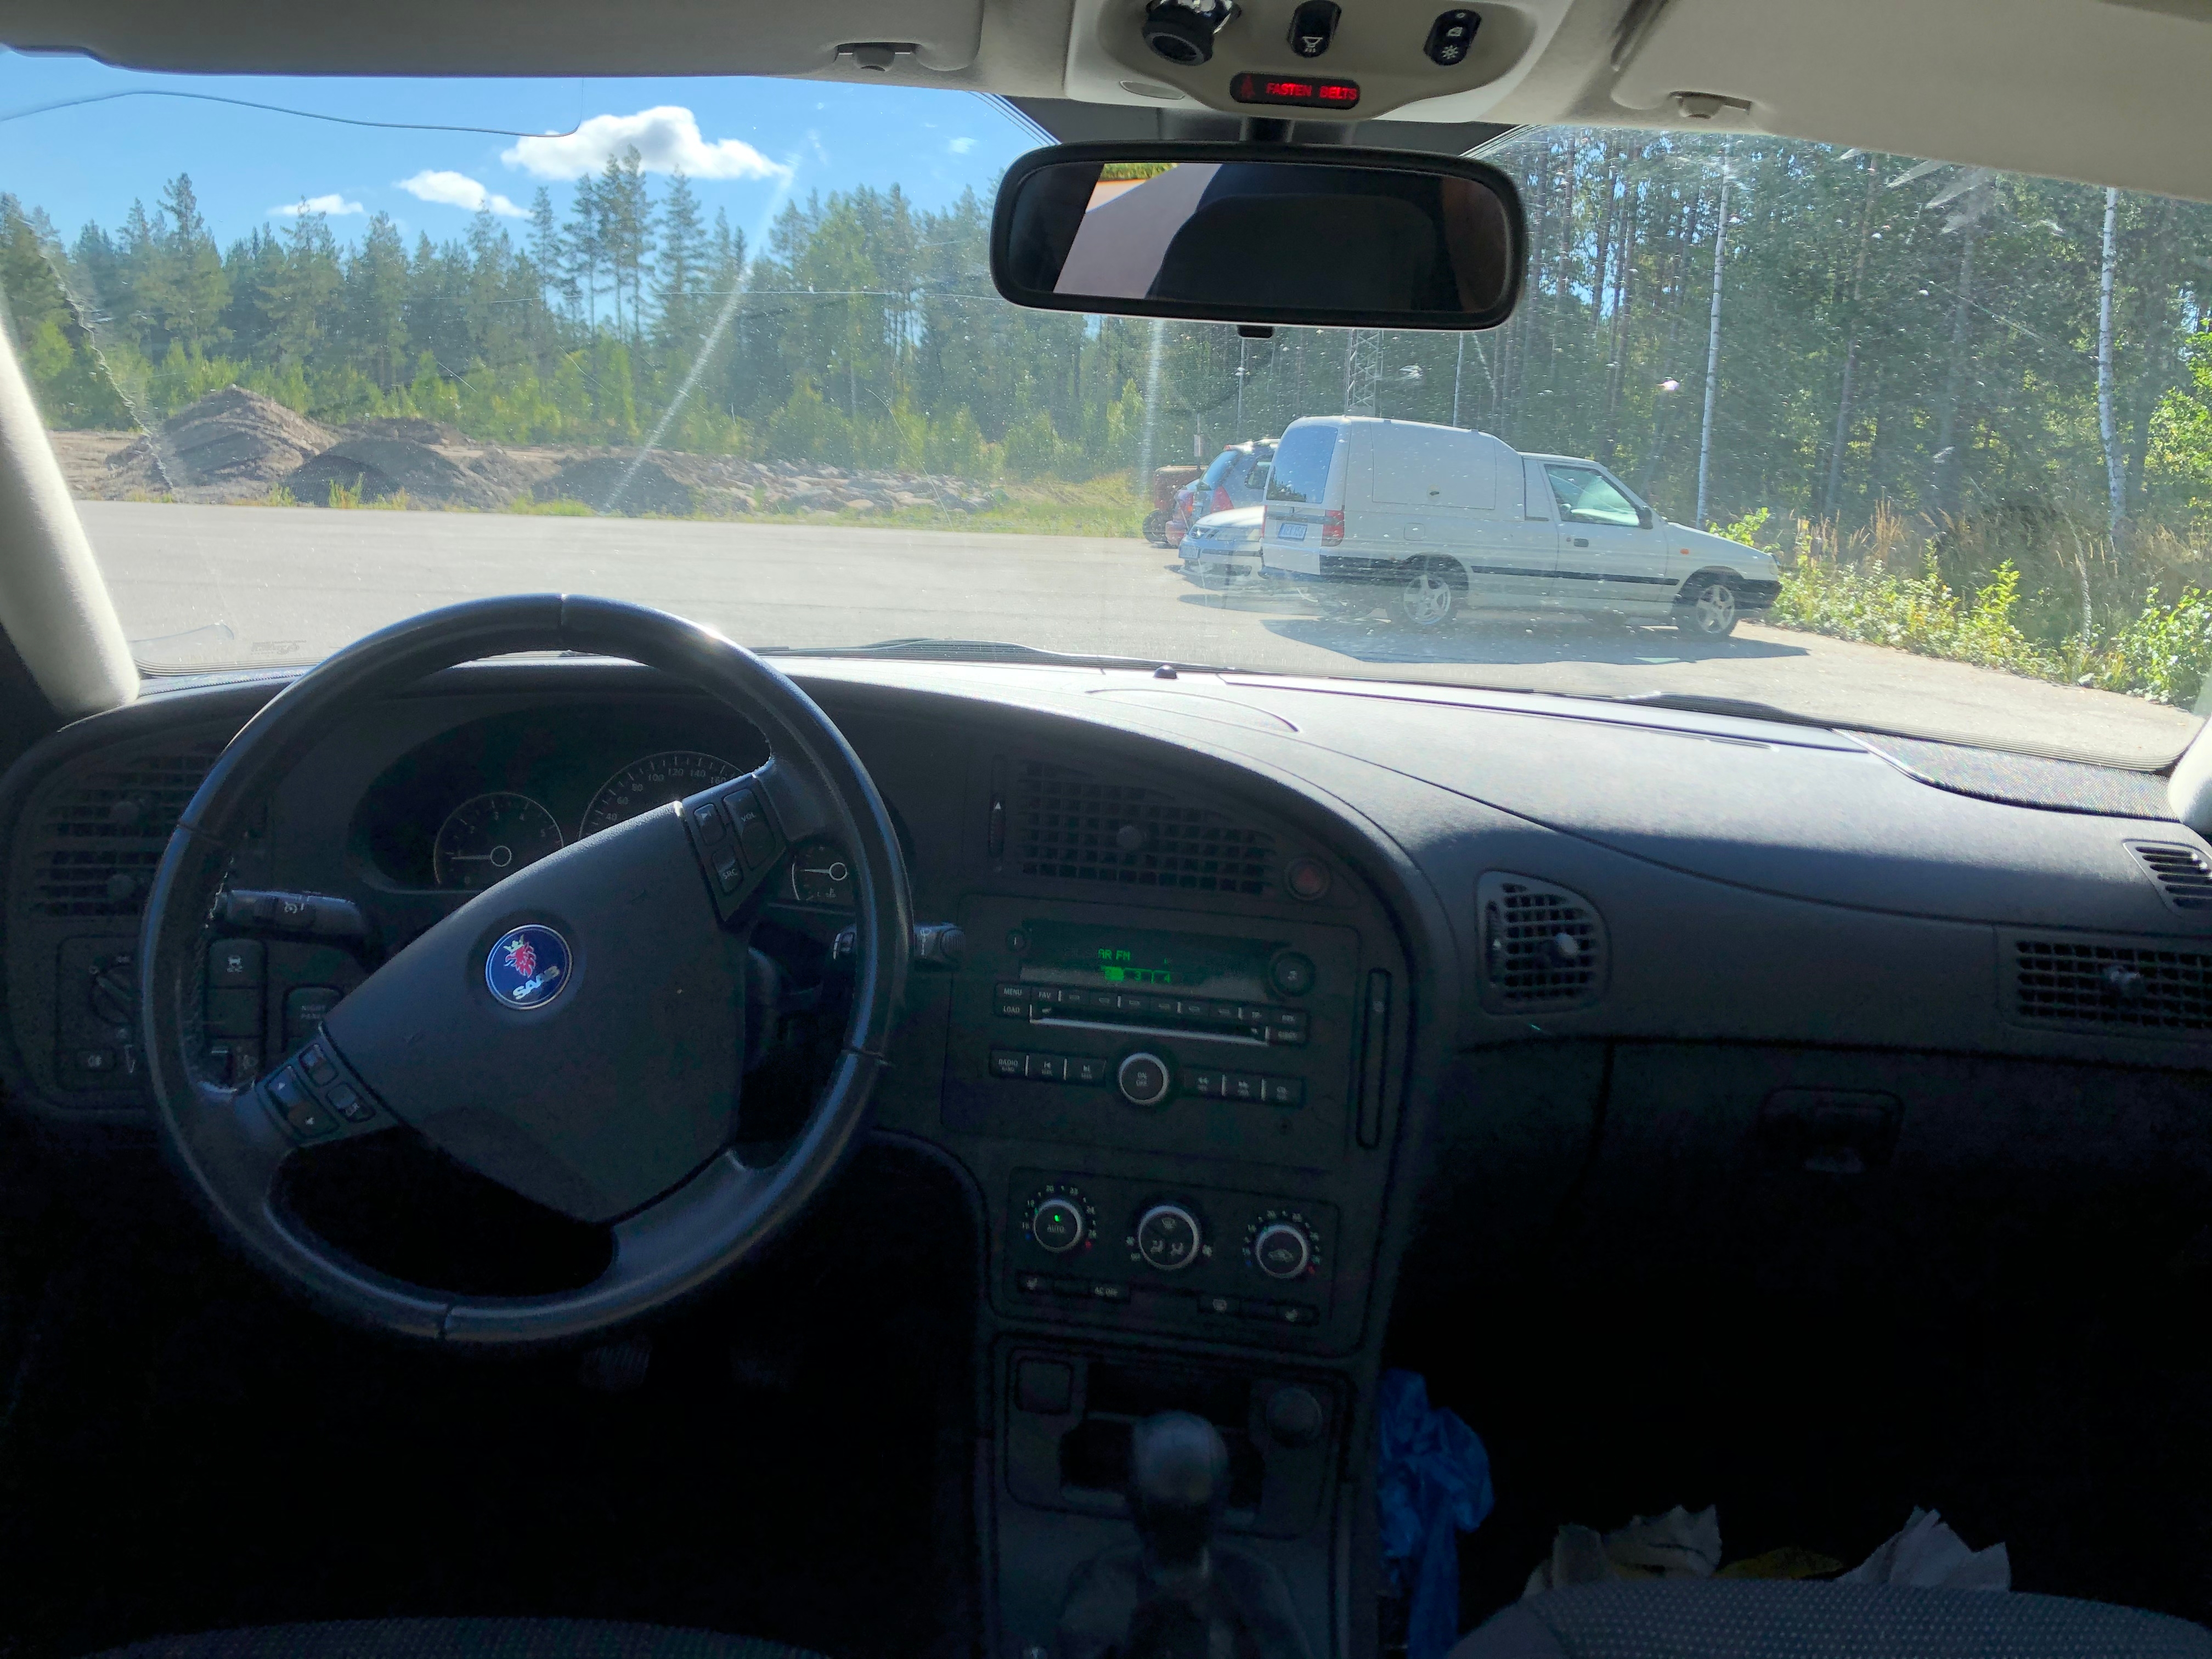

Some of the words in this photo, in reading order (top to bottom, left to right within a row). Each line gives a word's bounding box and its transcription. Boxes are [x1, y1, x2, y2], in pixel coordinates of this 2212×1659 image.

[1266, 82, 1312, 97] FASTEN
[1319, 86, 1357, 101] BELTS
[668, 768, 684, 776] 120
[690, 770, 706, 778] 140
[632, 784, 643, 792] 80
[617, 797, 629, 805] 60
[741, 811, 757, 822] VOL
[722, 868, 738, 880] SRC
[1116, 950, 1131, 961] FM
[1134, 970, 1142, 981] 3
[1003, 988, 1022, 996] MENU
[1038, 991, 1052, 1000] FAV
[1003, 1005, 1020, 1013] LOAD
[998, 1058, 1018, 1068] RADIO
[1047, 1224, 1066, 1234] AUTO
